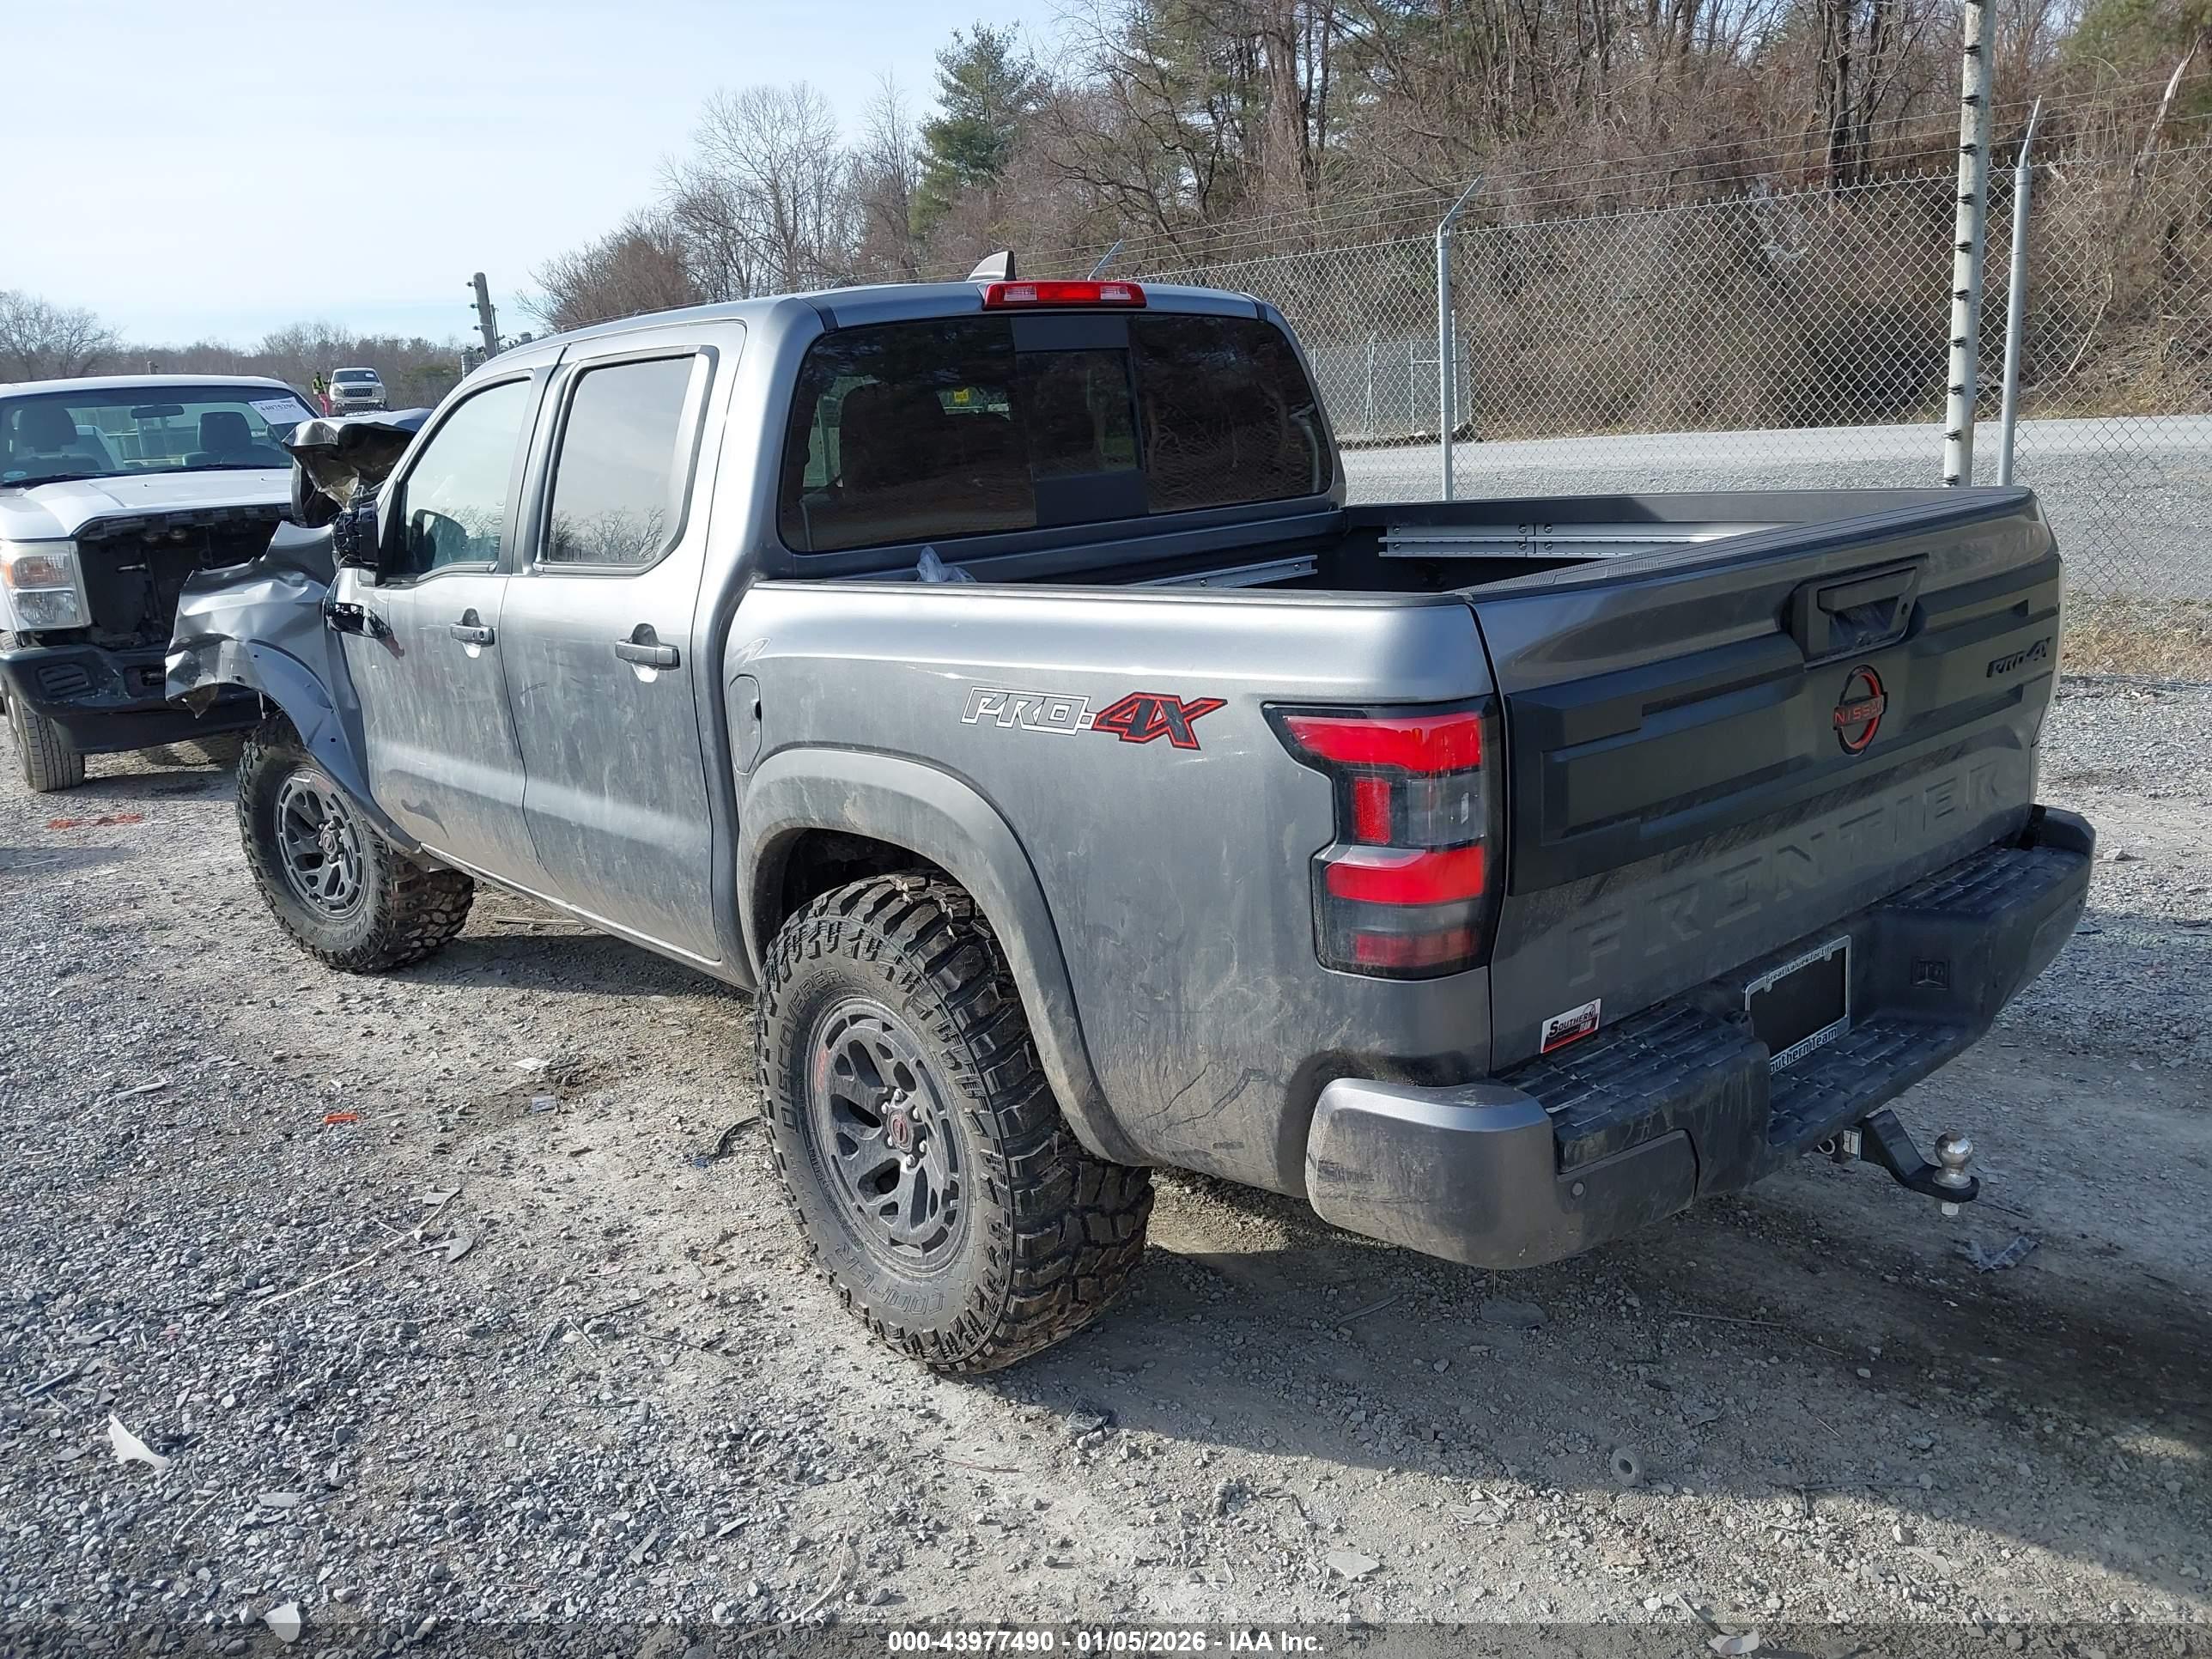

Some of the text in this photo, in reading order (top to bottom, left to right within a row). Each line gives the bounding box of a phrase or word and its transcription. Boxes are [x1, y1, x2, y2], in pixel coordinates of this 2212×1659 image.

[960, 686, 1228, 750] PRO-4X
[1834, 696, 1884, 725] NISSAN
[1567, 760, 2003, 988] FRONTIER
[1765, 969, 1785, 983] Great
[1786, 956, 1809, 974] Values
[1821, 944, 1834, 957] Life
[777, 968, 845, 1133] DISCOVERER
[1549, 1011, 1595, 1036] SOUTHERN
[1770, 1027, 1838, 1073] outhern Team
[835, 1245, 943, 1315] COOPER
